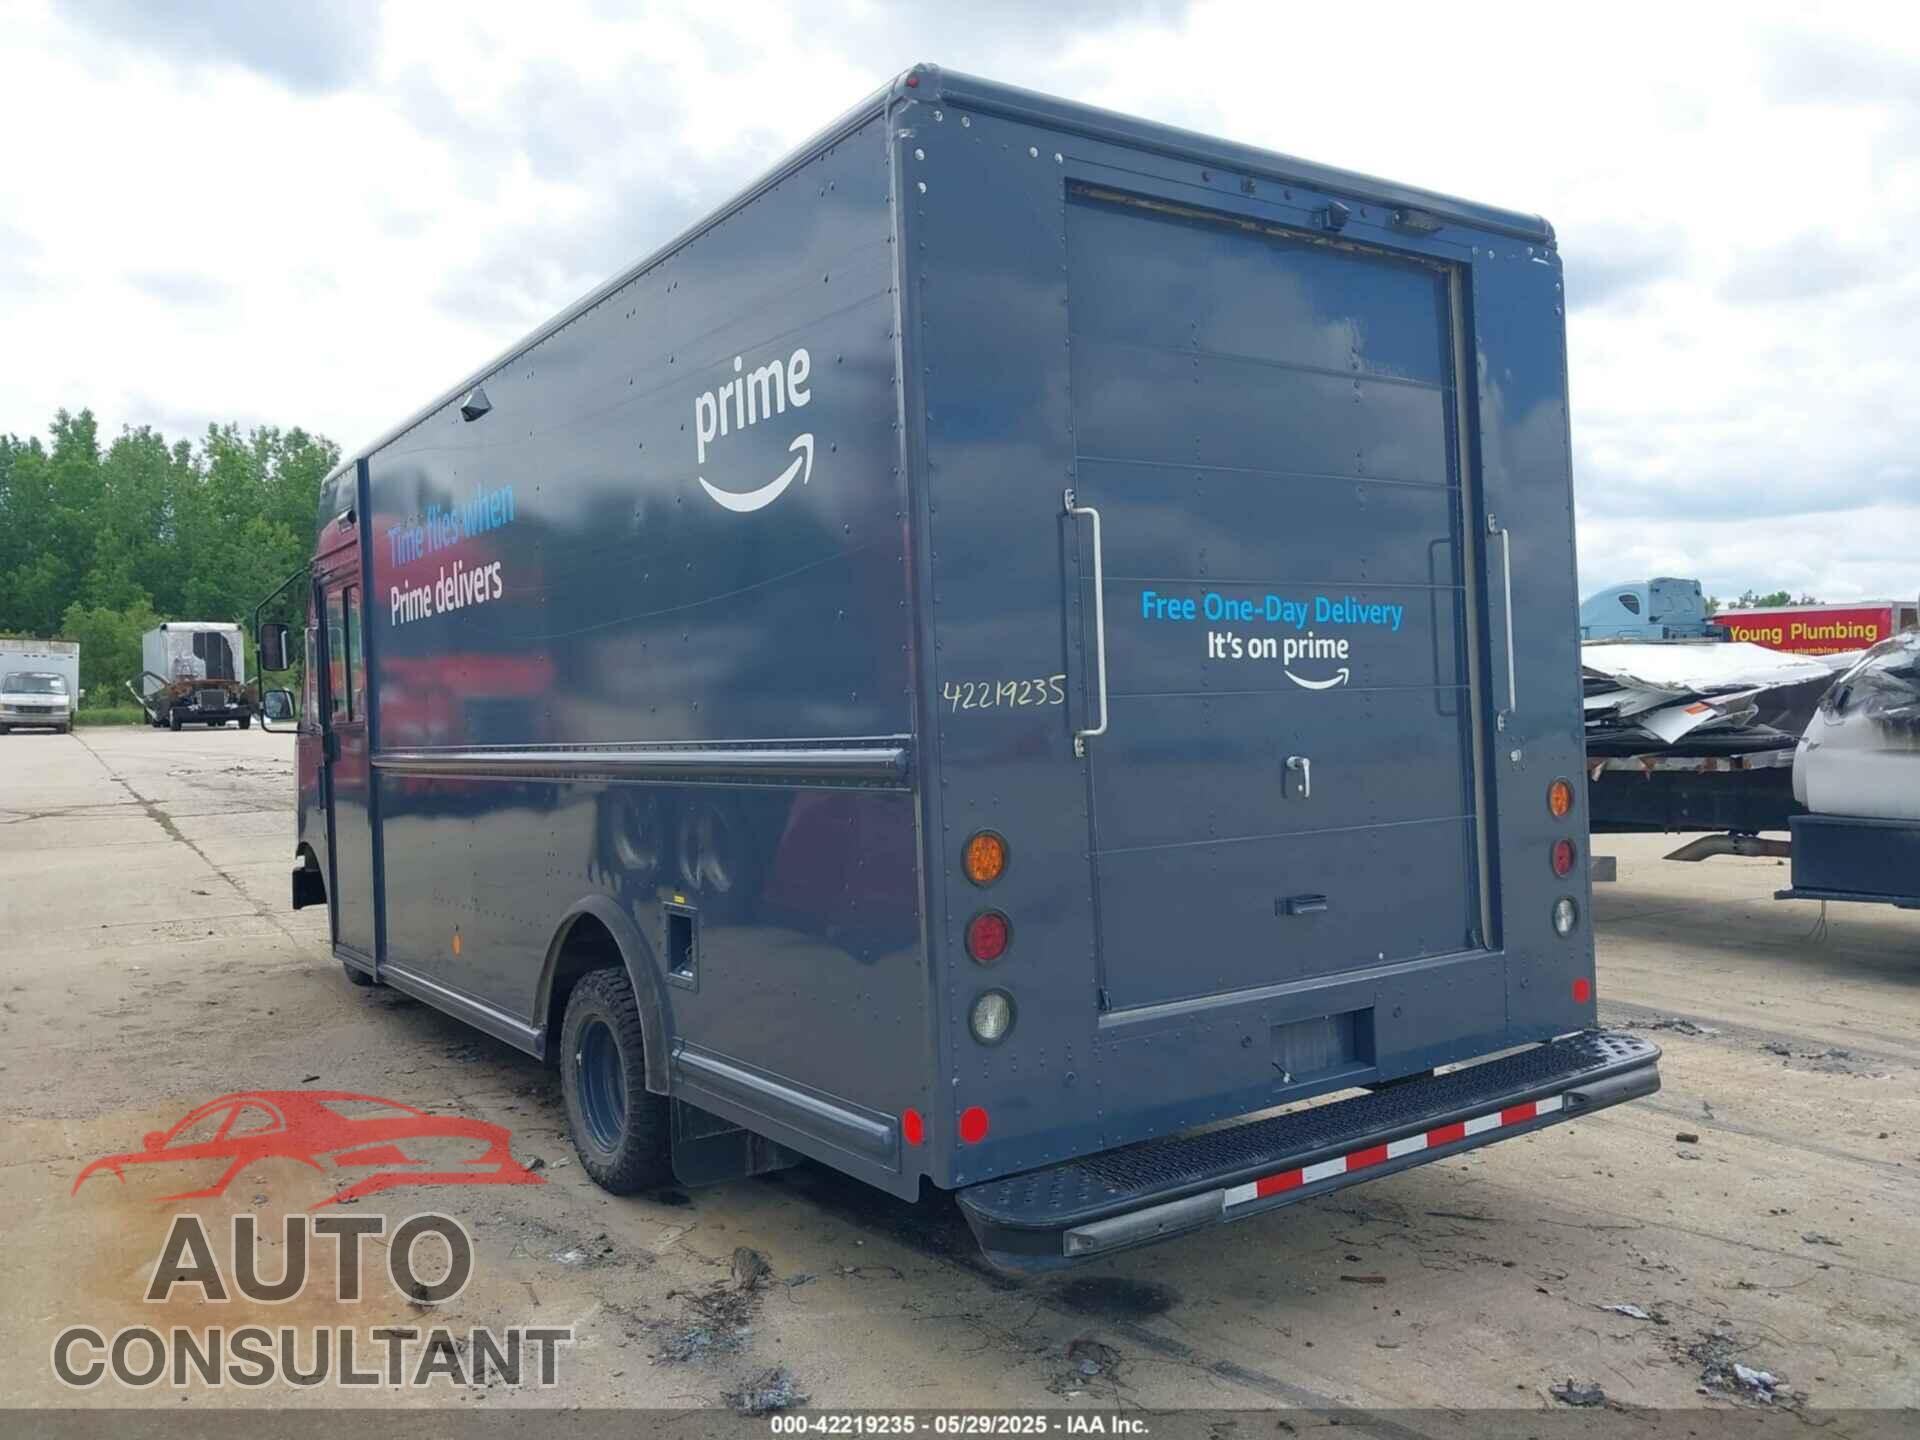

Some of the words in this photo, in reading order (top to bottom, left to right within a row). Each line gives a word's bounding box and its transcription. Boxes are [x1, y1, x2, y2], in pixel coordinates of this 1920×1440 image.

[695, 348, 811, 464] prime
[388, 524, 425, 569] Time
[427, 503, 460, 553] flies
[463, 481, 516, 538] when
[390, 578, 433, 627] Prime
[434, 559, 503, 614] delivers
[1141, 591, 1196, 621] Free
[1204, 593, 1308, 630] One-Day
[1315, 596, 1404, 632] Delivery
[1207, 631, 1244, 660] It's
[1247, 637, 1277, 660] on
[1283, 631, 1350, 666] prime
[1730, 625, 1782, 645] Young
[1790, 621, 1878, 642] Plumbing
[943, 674, 1067, 713] 42219235
